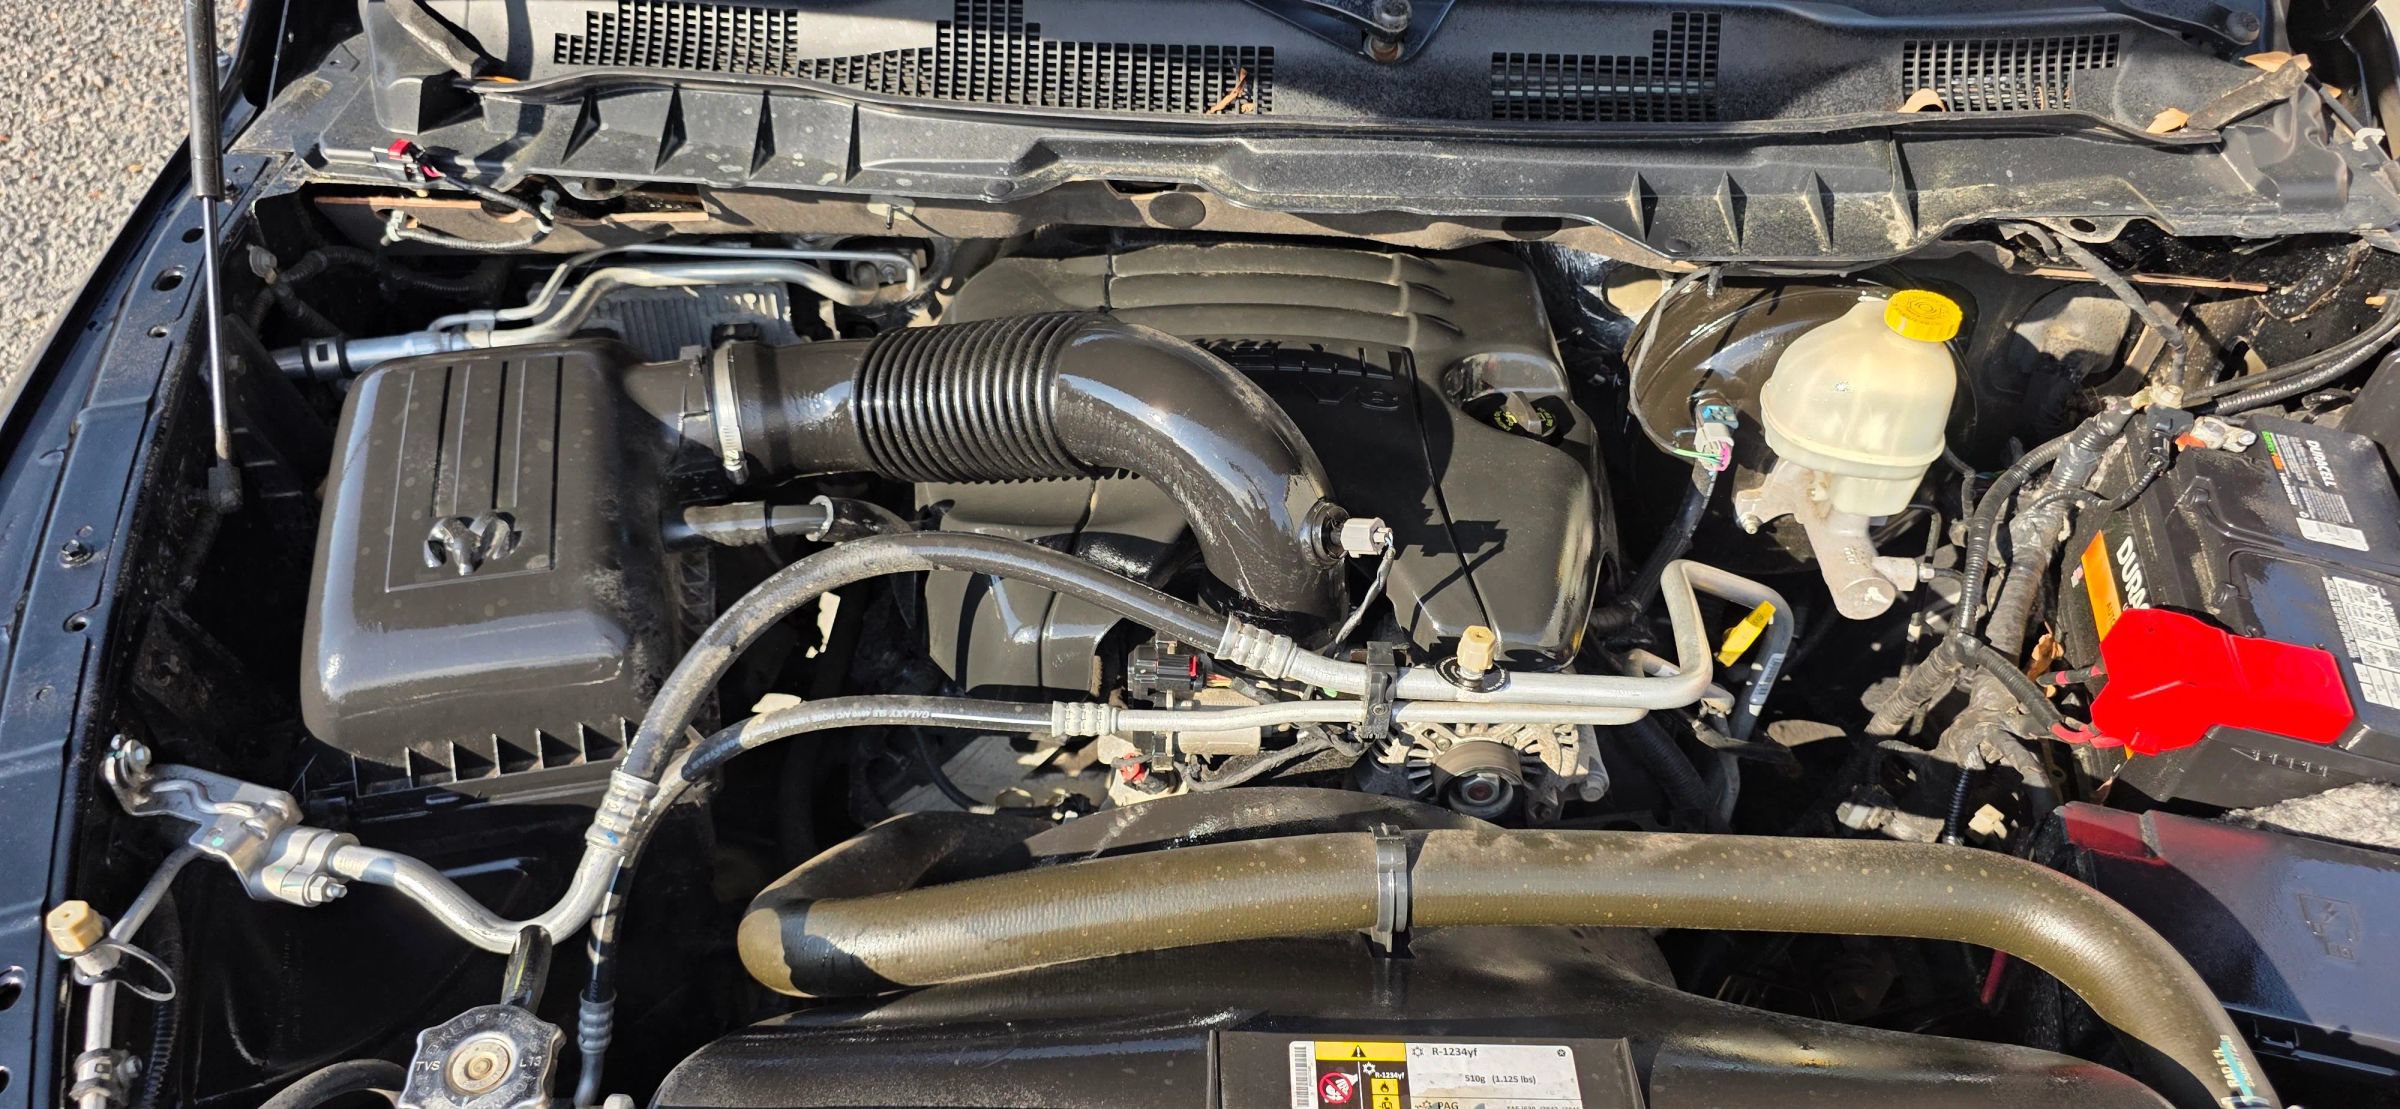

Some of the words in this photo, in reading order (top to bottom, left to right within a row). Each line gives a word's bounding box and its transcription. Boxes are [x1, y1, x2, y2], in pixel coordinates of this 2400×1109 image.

[2306, 440, 2337, 487] DURACELL
[889, 709, 929, 719] GALAXY
[1432, 1047, 1478, 1059] R-1234yf
[416, 1060, 441, 1072] TVS
[1464, 1074, 1486, 1084] 510g
[1492, 1074, 1519, 1085] (1.125
[1521, 1074, 1537, 1085] lbs)
[1438, 1101, 1459, 1109] PAG
